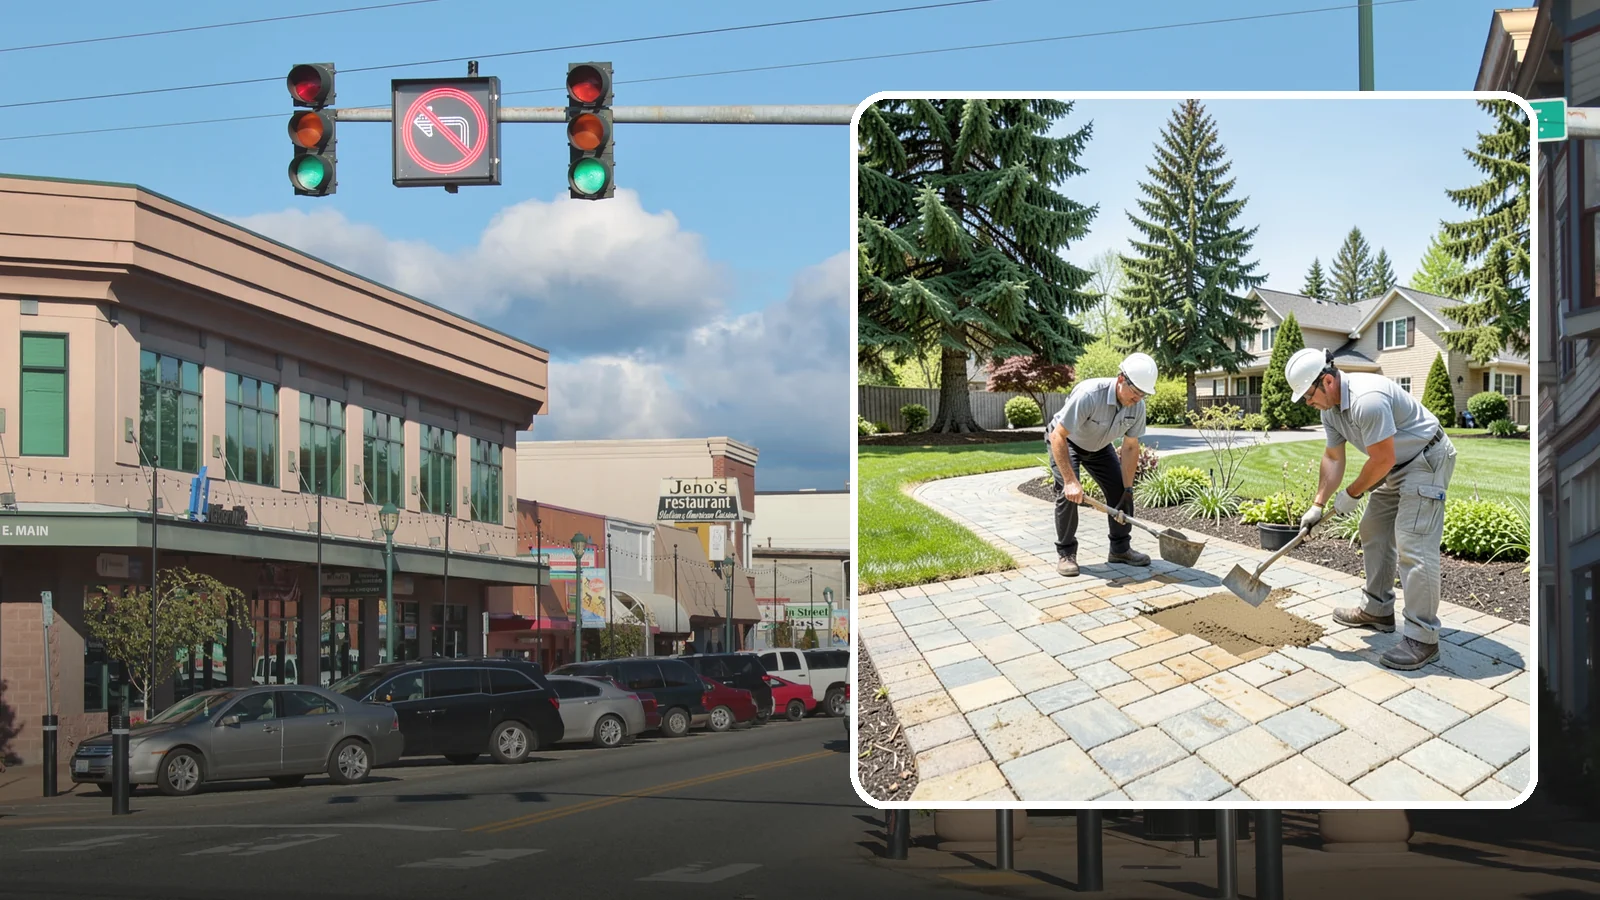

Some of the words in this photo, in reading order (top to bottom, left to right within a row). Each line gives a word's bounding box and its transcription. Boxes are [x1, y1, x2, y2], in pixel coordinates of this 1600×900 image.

[669, 480, 727, 494] Jeno's
[665, 496, 731, 509] restaurant
[659, 510, 681, 519] Italian
[686, 510, 715, 519] American
[715, 510, 737, 519] Cuisine
[2, 525, 13, 536] E.
[15, 525, 49, 536] MAIN
[797, 607, 828, 616] Street
